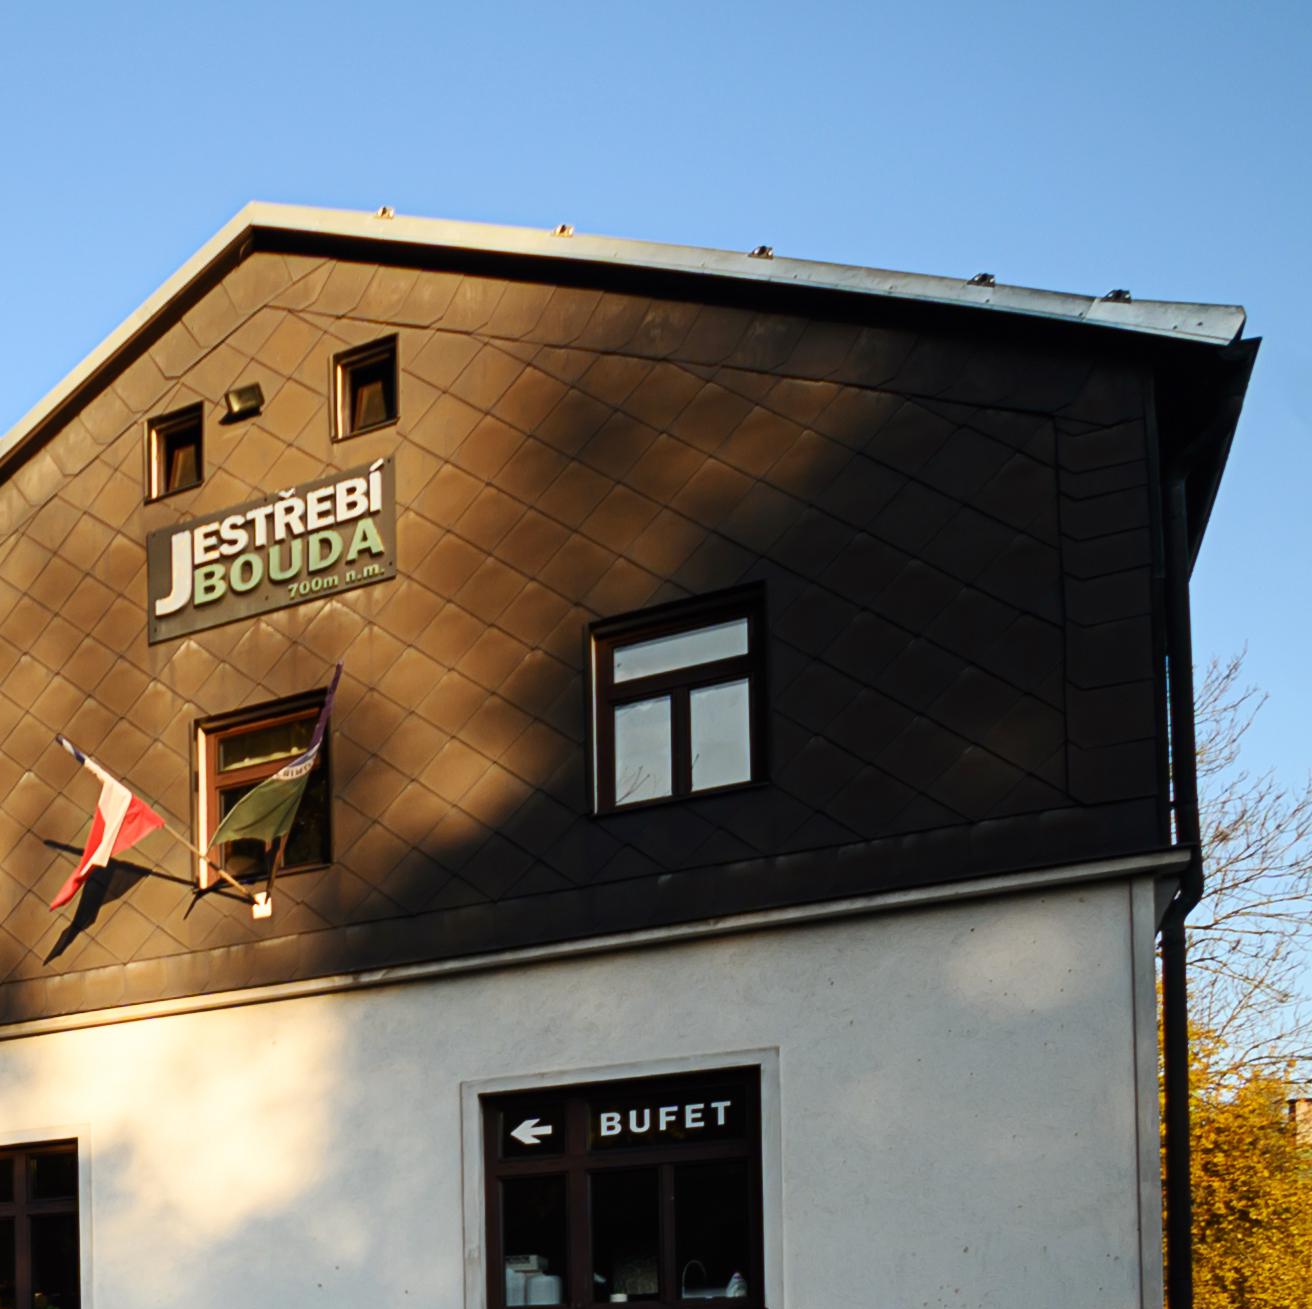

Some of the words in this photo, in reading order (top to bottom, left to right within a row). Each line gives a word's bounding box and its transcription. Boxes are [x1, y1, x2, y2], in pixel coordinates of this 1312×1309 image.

[155, 458, 385, 617] JESTŘEBÍ
[194, 517, 385, 607] BOUDA
[288, 575, 339, 599] 700m
[345, 562, 386, 584] n.m.
[600, 1100, 732, 1137] BUFET
